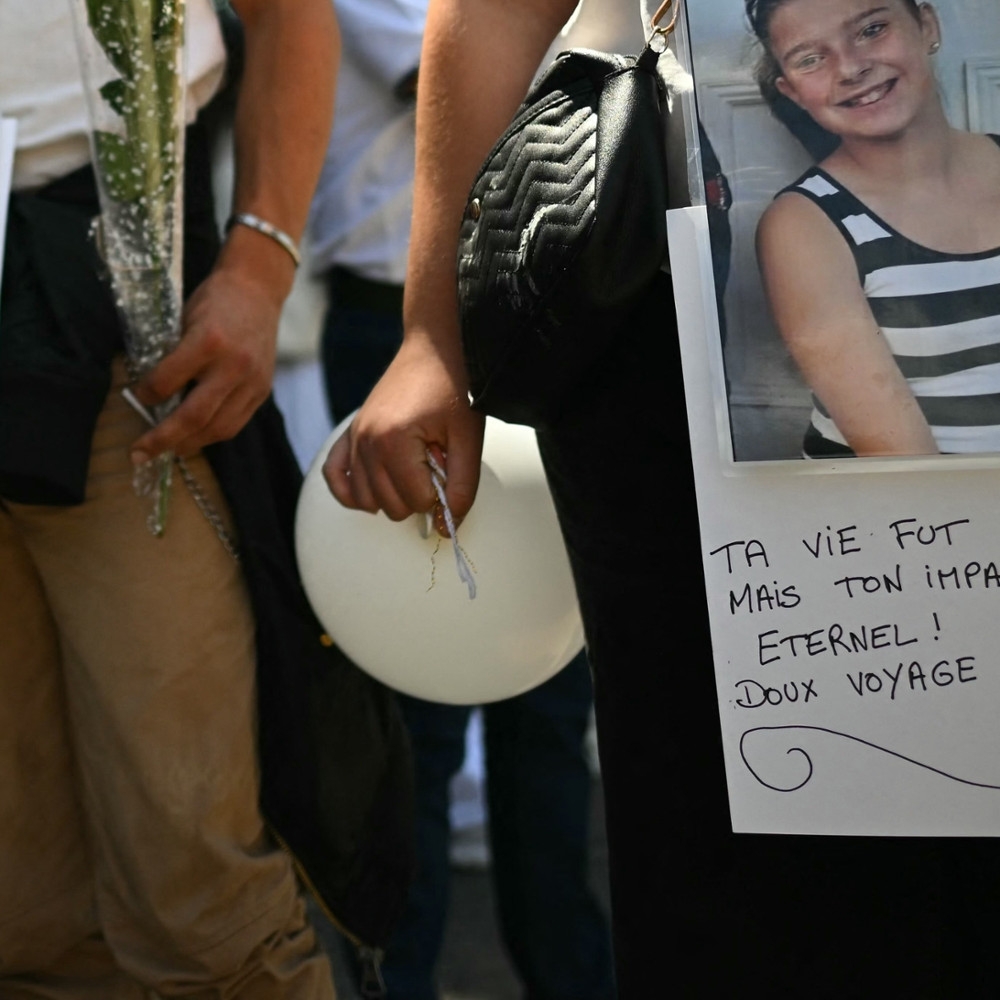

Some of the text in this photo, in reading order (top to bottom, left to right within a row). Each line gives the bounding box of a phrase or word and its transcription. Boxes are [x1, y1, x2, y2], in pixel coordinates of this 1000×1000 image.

[710, 540, 769, 573] TA
[889, 518, 969, 549] FUT
[834, 564, 902, 597] TON
[758, 623, 918, 665] ETERNEL
[735, 656, 977, 708] DOUX VOYAGE
